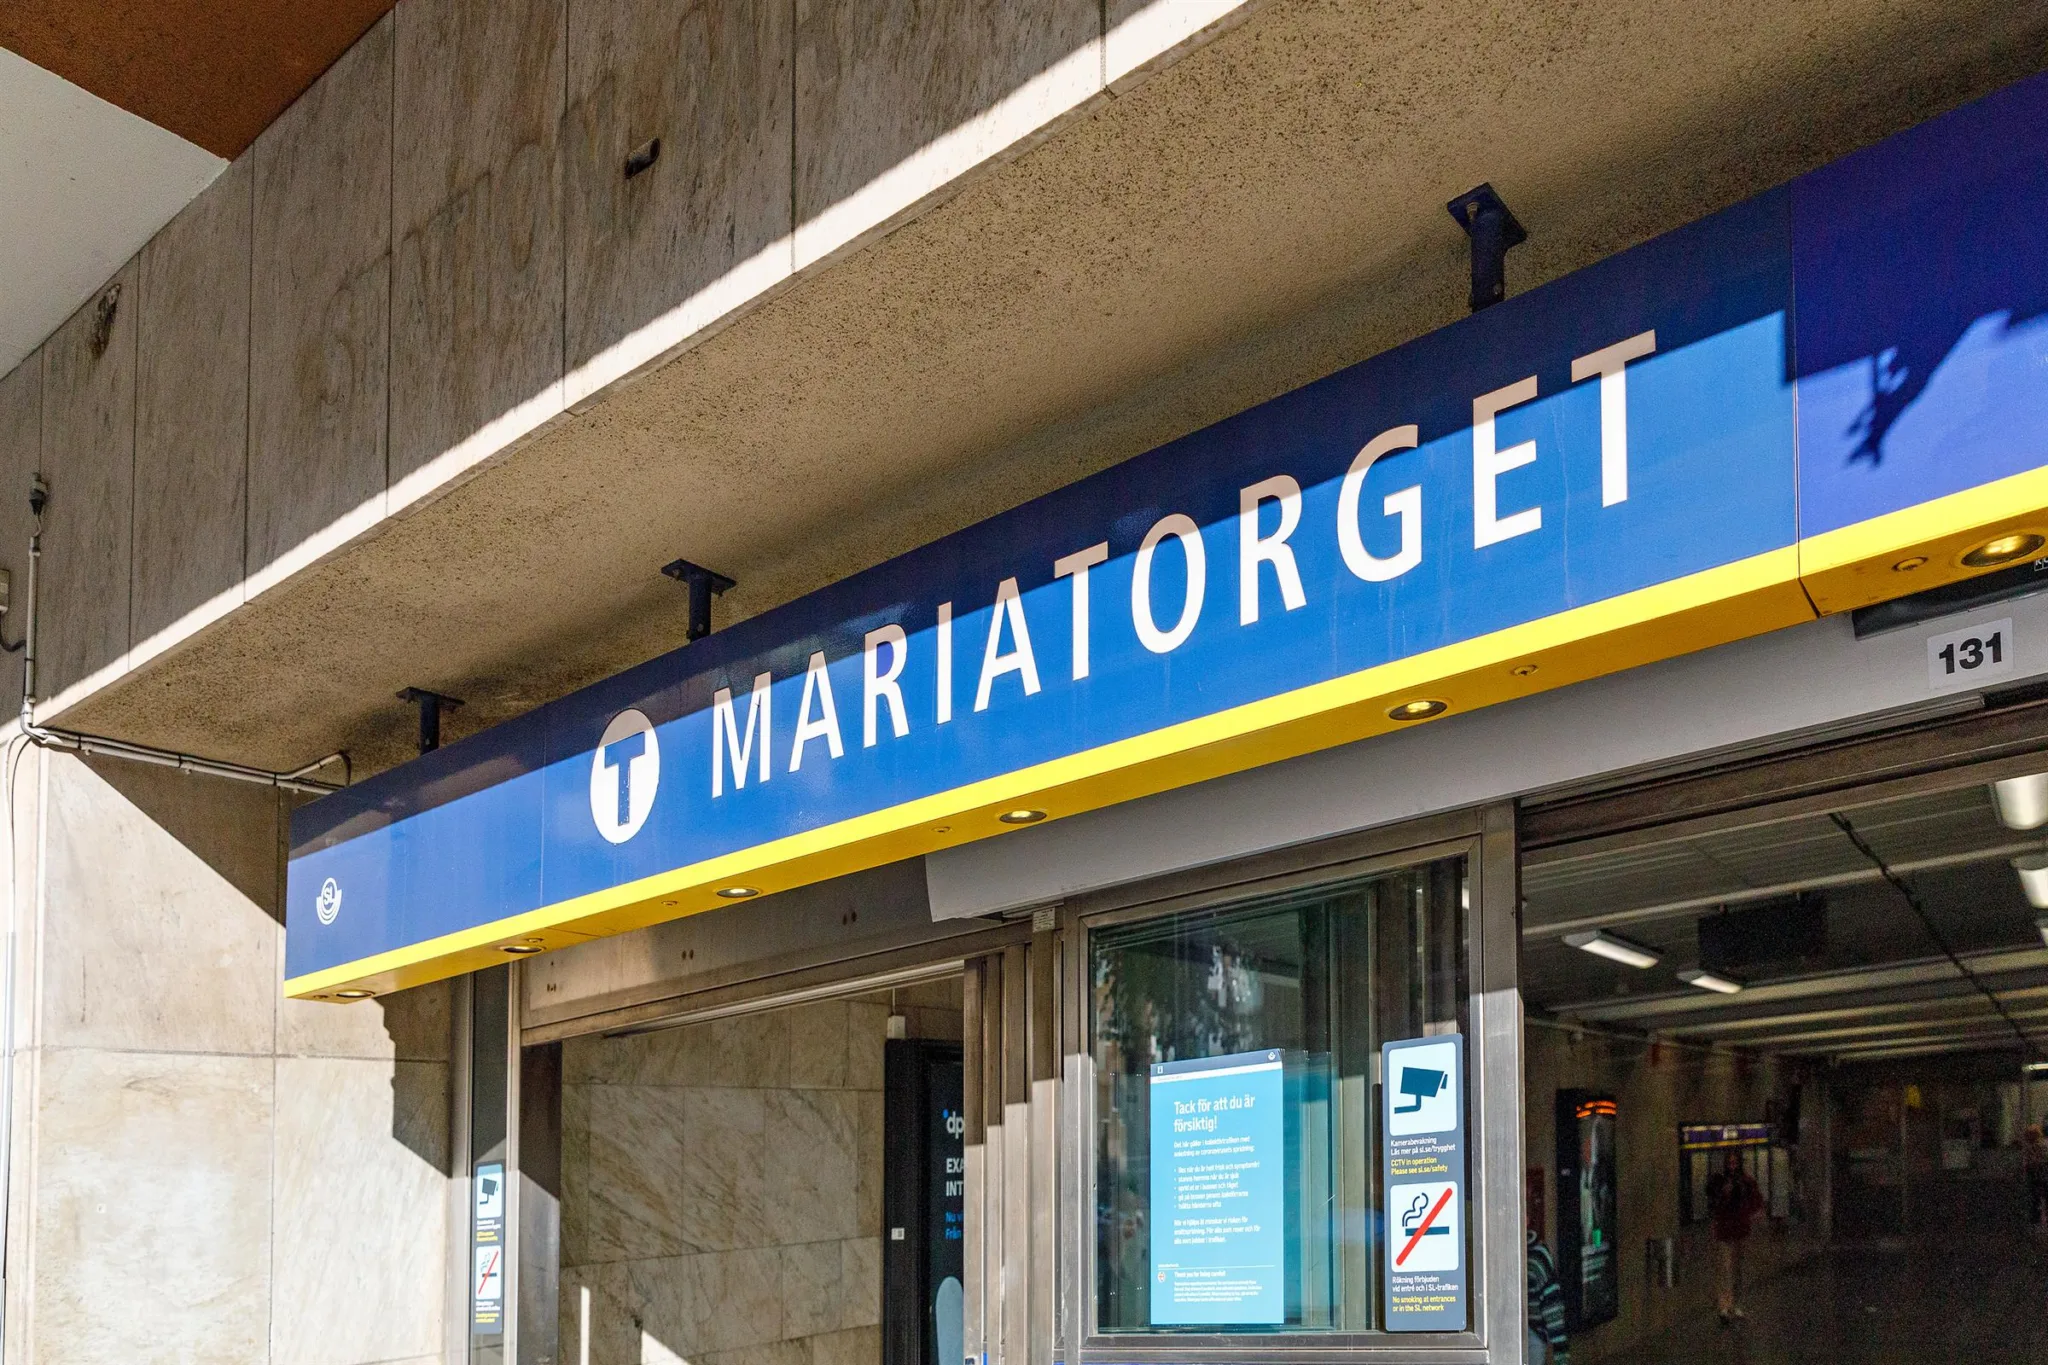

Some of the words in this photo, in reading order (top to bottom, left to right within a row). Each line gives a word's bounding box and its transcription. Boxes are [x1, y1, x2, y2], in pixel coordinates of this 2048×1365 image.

[711, 329, 1656, 799] MARIATORGET
[1939, 631, 2002, 674] 131
[604, 731, 645, 826] T
[1174, 1100, 1195, 1115] Tack
[1198, 1098, 1211, 1113] för
[1214, 1097, 1228, 1111] att
[1230, 1095, 1242, 1109] du
[1244, 1094, 1256, 1108] är
[1173, 1115, 1217, 1133] försiktig!
[1390, 1137, 1437, 1147] Kamerabevakning
[1412, 1146, 1419, 1155] på
[1391, 1158, 1405, 1166] CCTV
[1412, 1157, 1437, 1166] operation
[1414, 1274, 1440, 1284] förbjuden
[1401, 1284, 1414, 1292] entré
[1400, 1295, 1422, 1304] smoking
